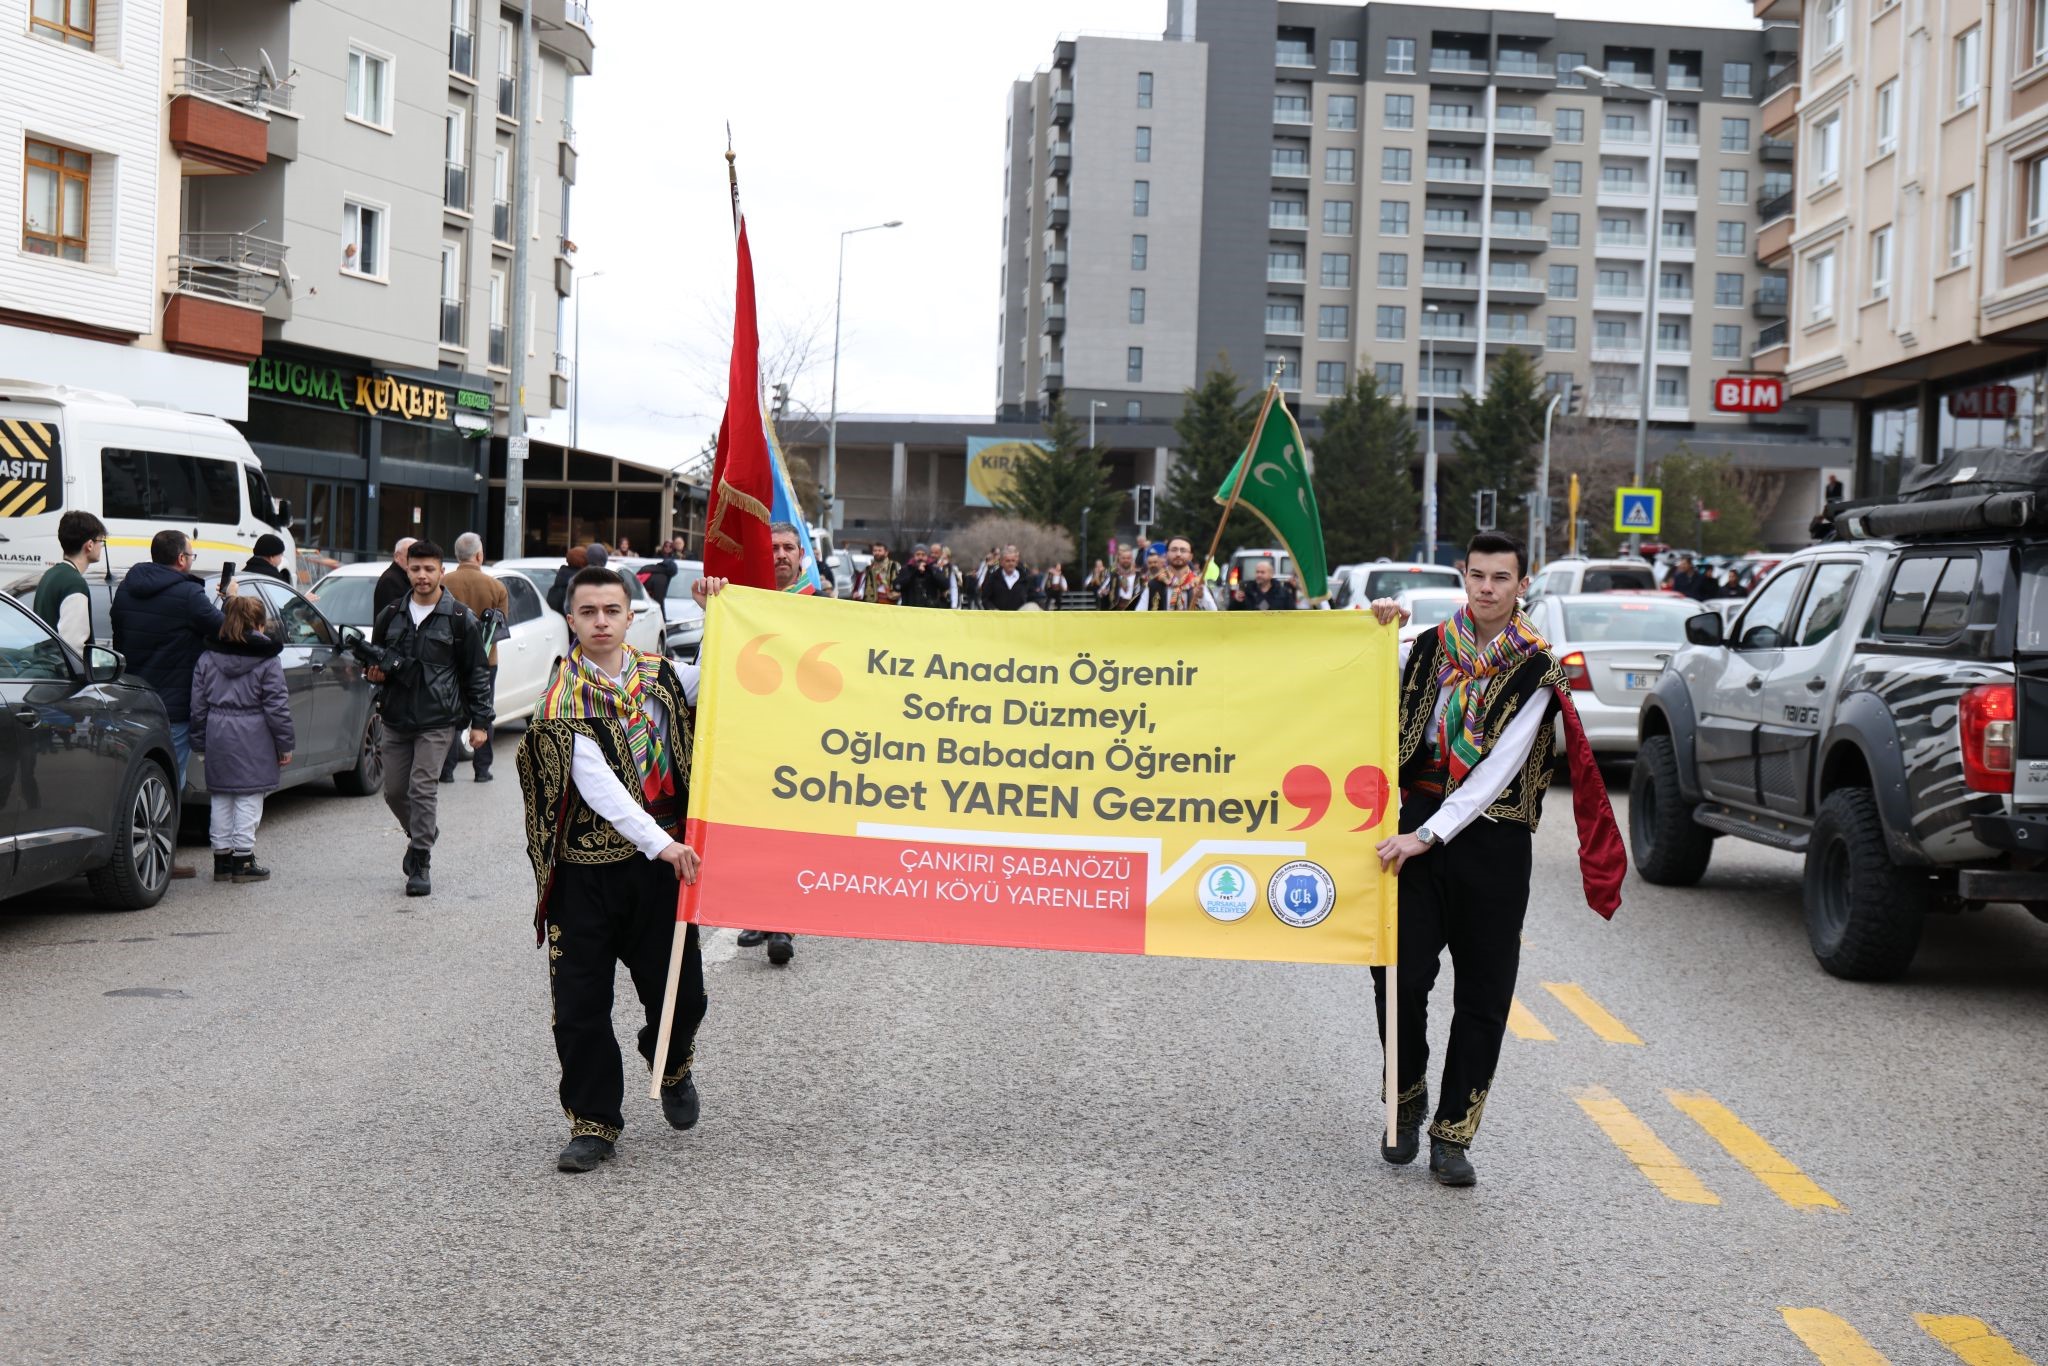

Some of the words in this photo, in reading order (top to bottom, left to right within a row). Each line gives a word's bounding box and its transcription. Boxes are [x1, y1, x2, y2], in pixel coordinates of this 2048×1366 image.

[249, 357, 350, 411] ZEUGMA
[355, 375, 449, 421] KÜNEFE
[1721, 378, 1778, 408] BİM
[867, 648, 915, 678] Kız
[923, 653, 1059, 685] Anadan
[1069, 651, 1199, 693] Öğrenir
[902, 692, 992, 724] Sofra
[1003, 699, 1157, 736] Düzmeyi,
[820, 728, 926, 765] Oğlan
[936, 737, 1095, 771] Babadan
[1105, 737, 1237, 780] Öğrenir
[771, 765, 928, 811] Sohbet
[940, 779, 1079, 819] YAREN
[1092, 786, 1279, 834] Gezmeyi
[900, 849, 995, 873] ÇANKIRI
[1001, 855, 1131, 880] ŞABANÖZÜ
[797, 869, 928, 899] ÇAPARKAYI
[935, 879, 1000, 904] KÖYÜ
[1007, 885, 1130, 910] YARENLERİ
